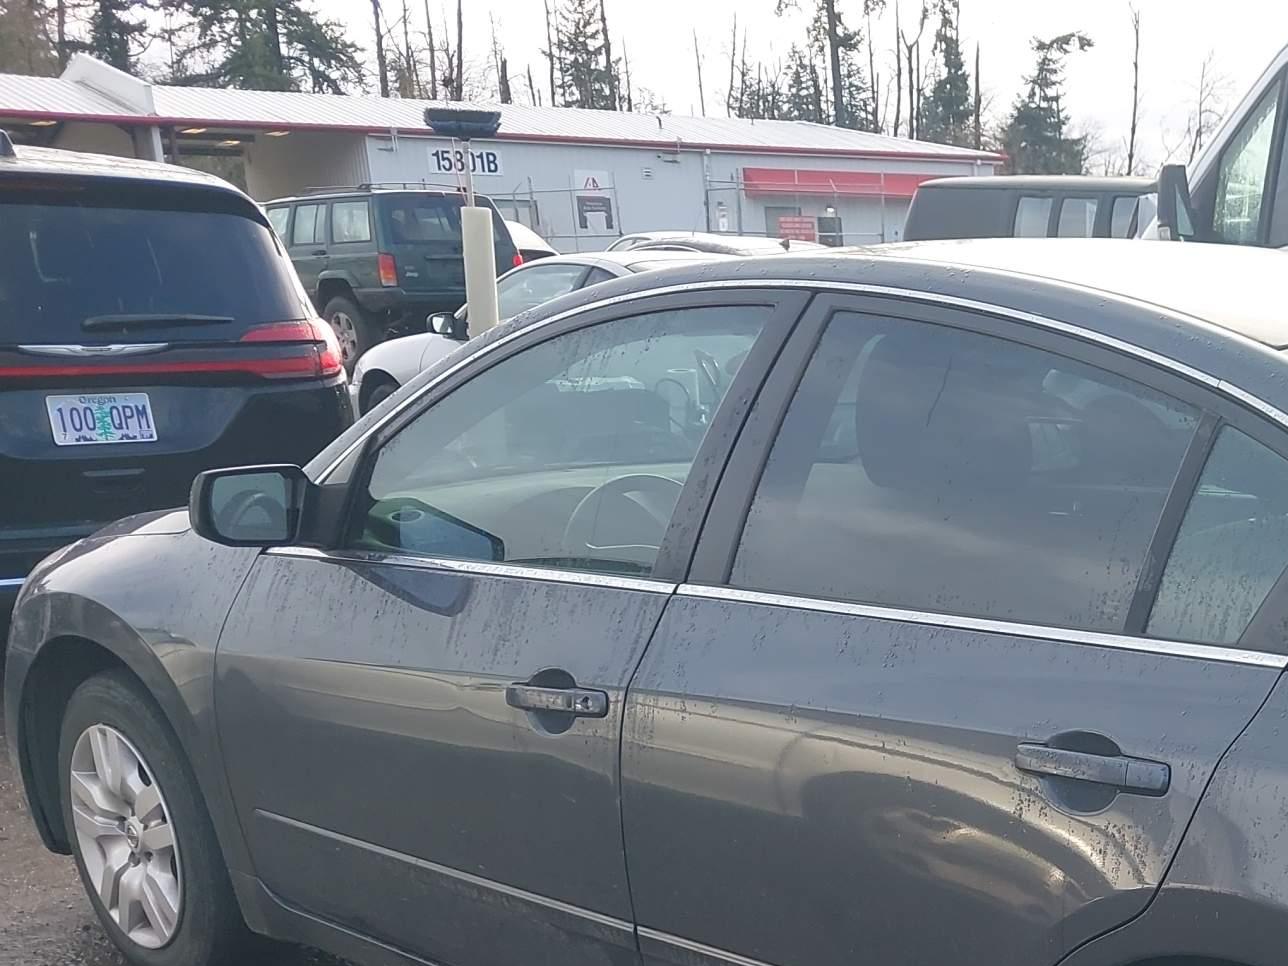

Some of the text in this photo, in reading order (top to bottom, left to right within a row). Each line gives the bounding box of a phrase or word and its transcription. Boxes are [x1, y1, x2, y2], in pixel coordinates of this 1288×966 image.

[78, 396, 117, 406] Oregon
[57, 404, 151, 433] 100 QPM
